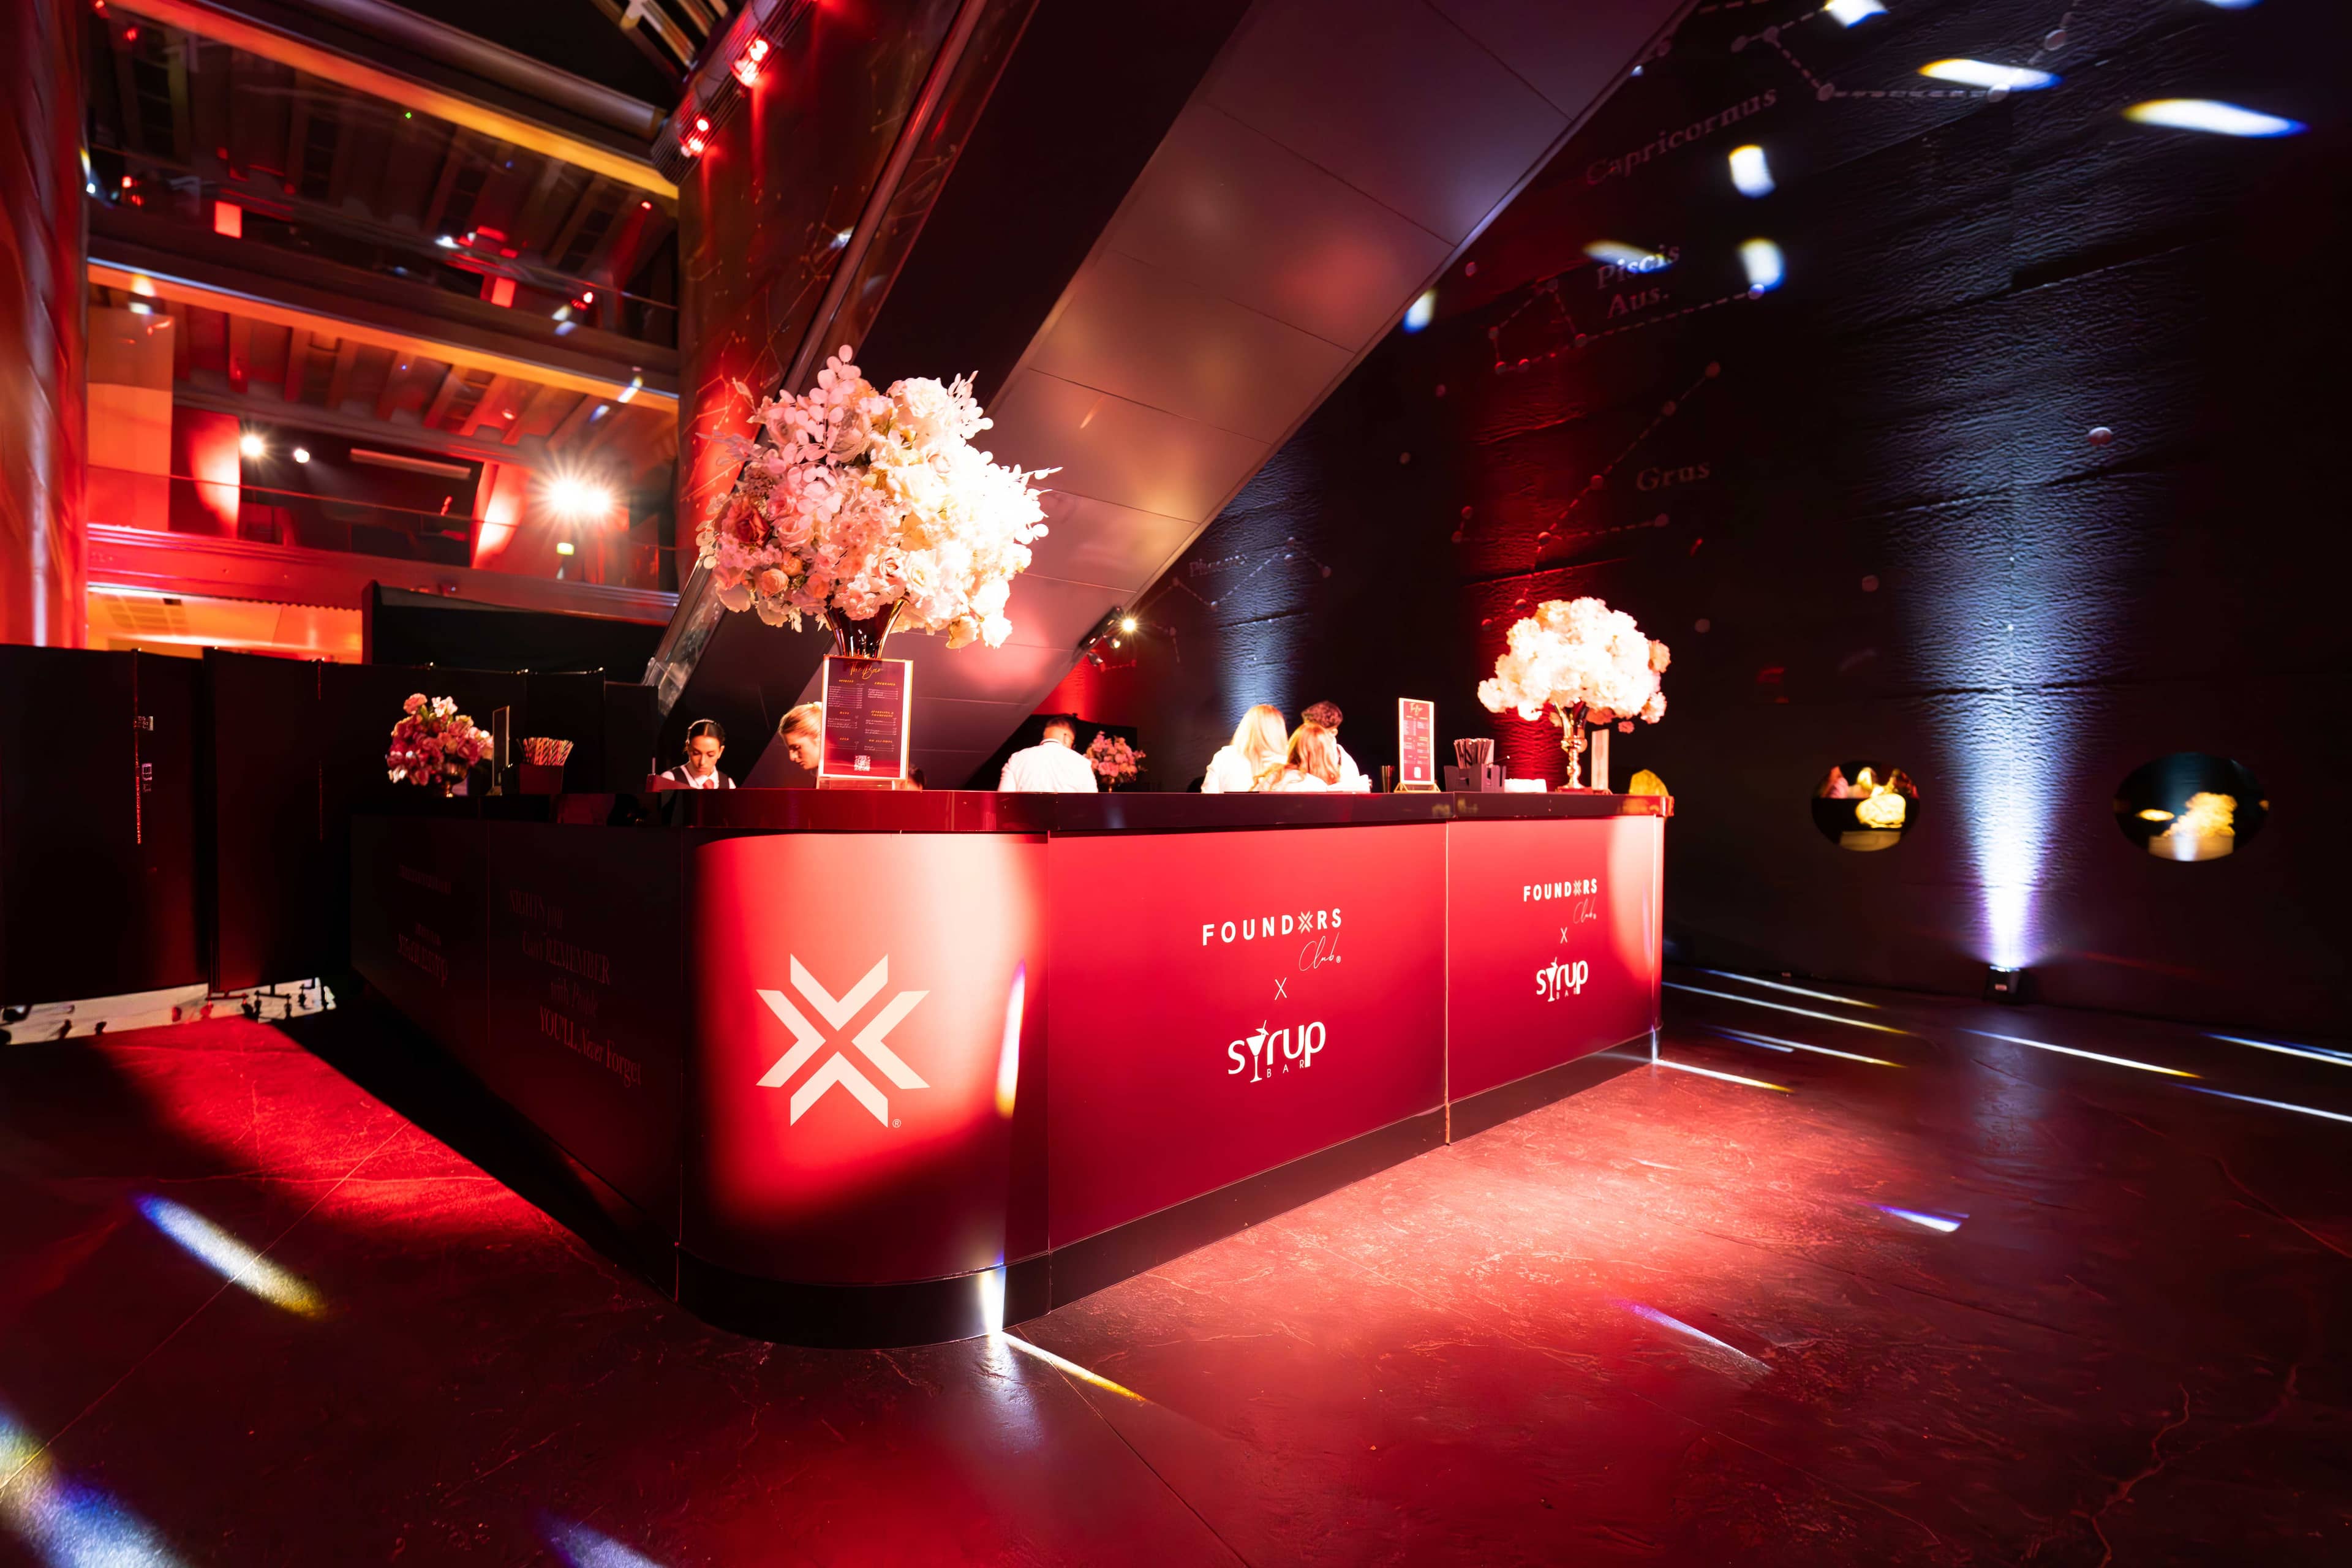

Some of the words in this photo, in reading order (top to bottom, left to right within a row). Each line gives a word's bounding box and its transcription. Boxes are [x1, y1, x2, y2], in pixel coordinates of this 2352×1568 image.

[1588, 88, 1778, 186] Capricornus
[1597, 244, 1679, 289] Piscis
[1607, 287, 1670, 320] Aus.
[1636, 461, 1711, 491] Grus
[1267, 1059, 1305, 1079] BAR
